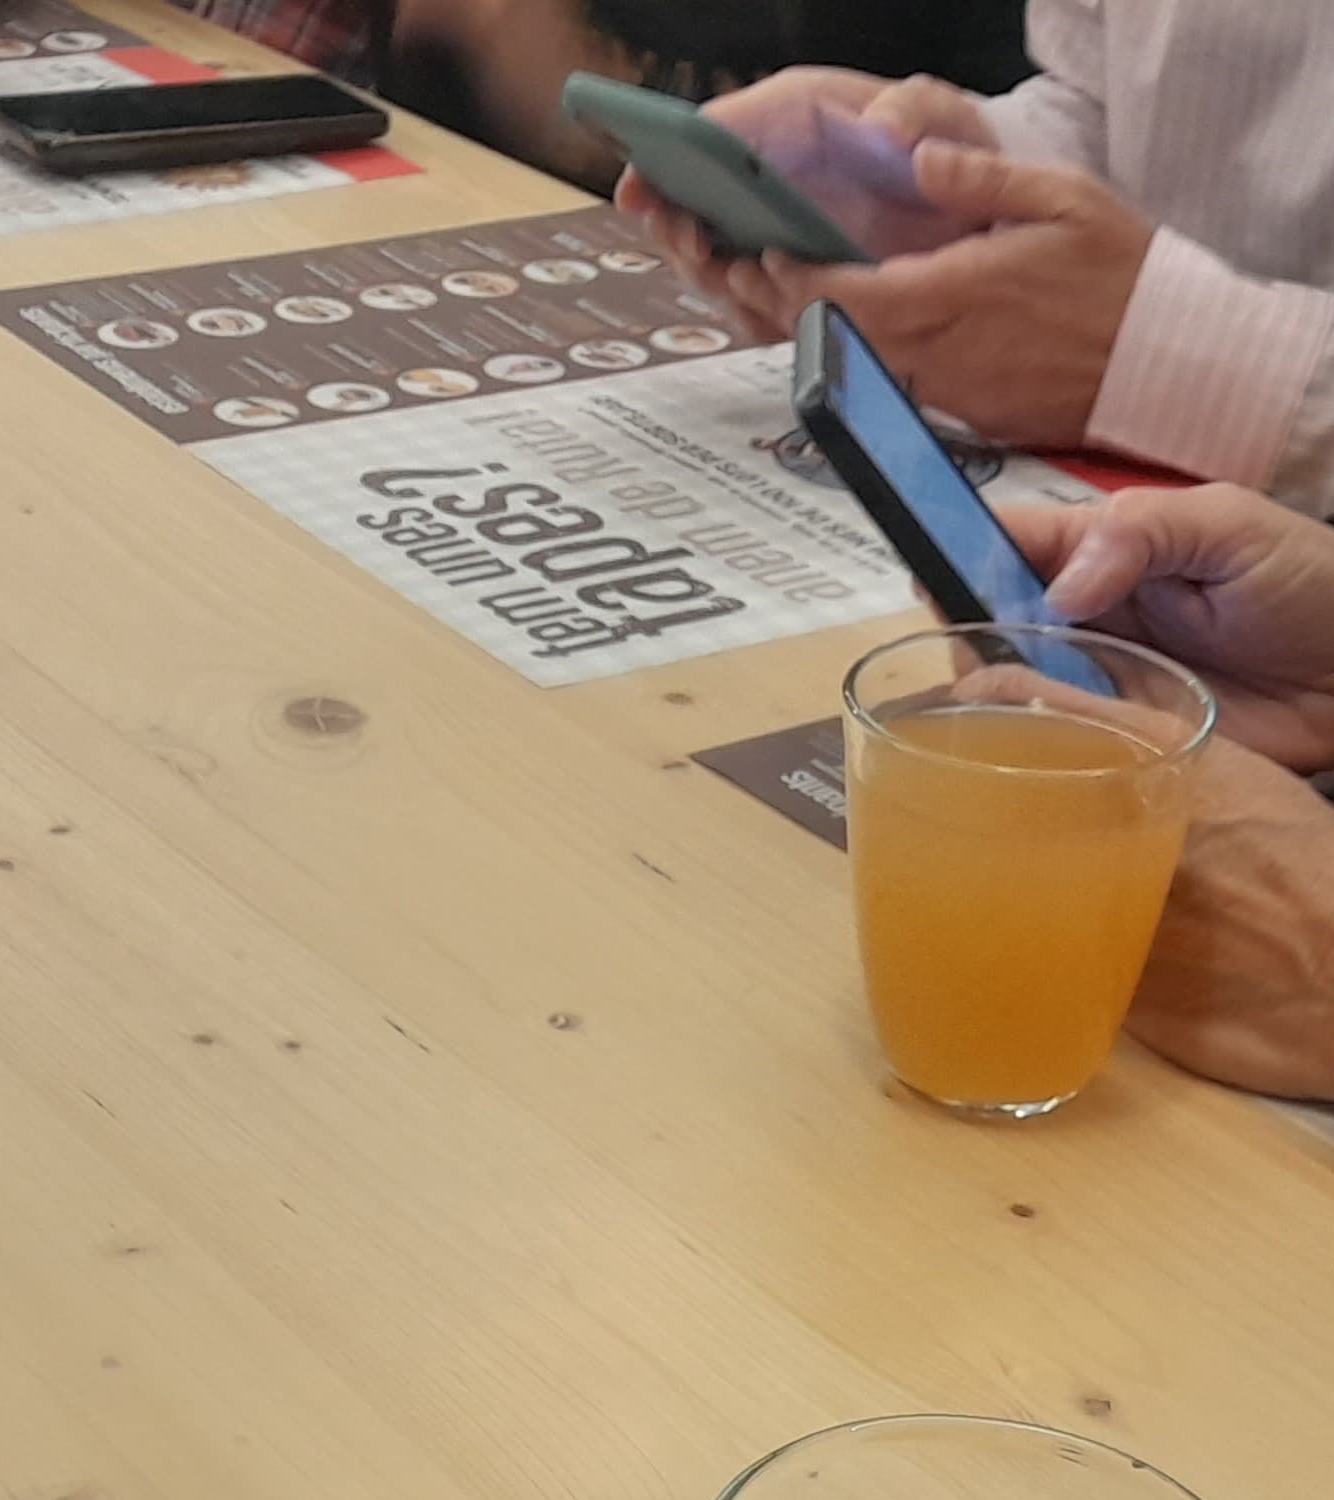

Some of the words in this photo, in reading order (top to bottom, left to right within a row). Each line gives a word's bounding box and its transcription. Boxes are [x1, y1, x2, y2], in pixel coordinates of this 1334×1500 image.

[459, 406, 642, 485] Ruta!
[591, 479, 712, 524] de
[346, 504, 522, 586] unes
[362, 461, 747, 635] tapes?
[672, 521, 862, 608] anem
